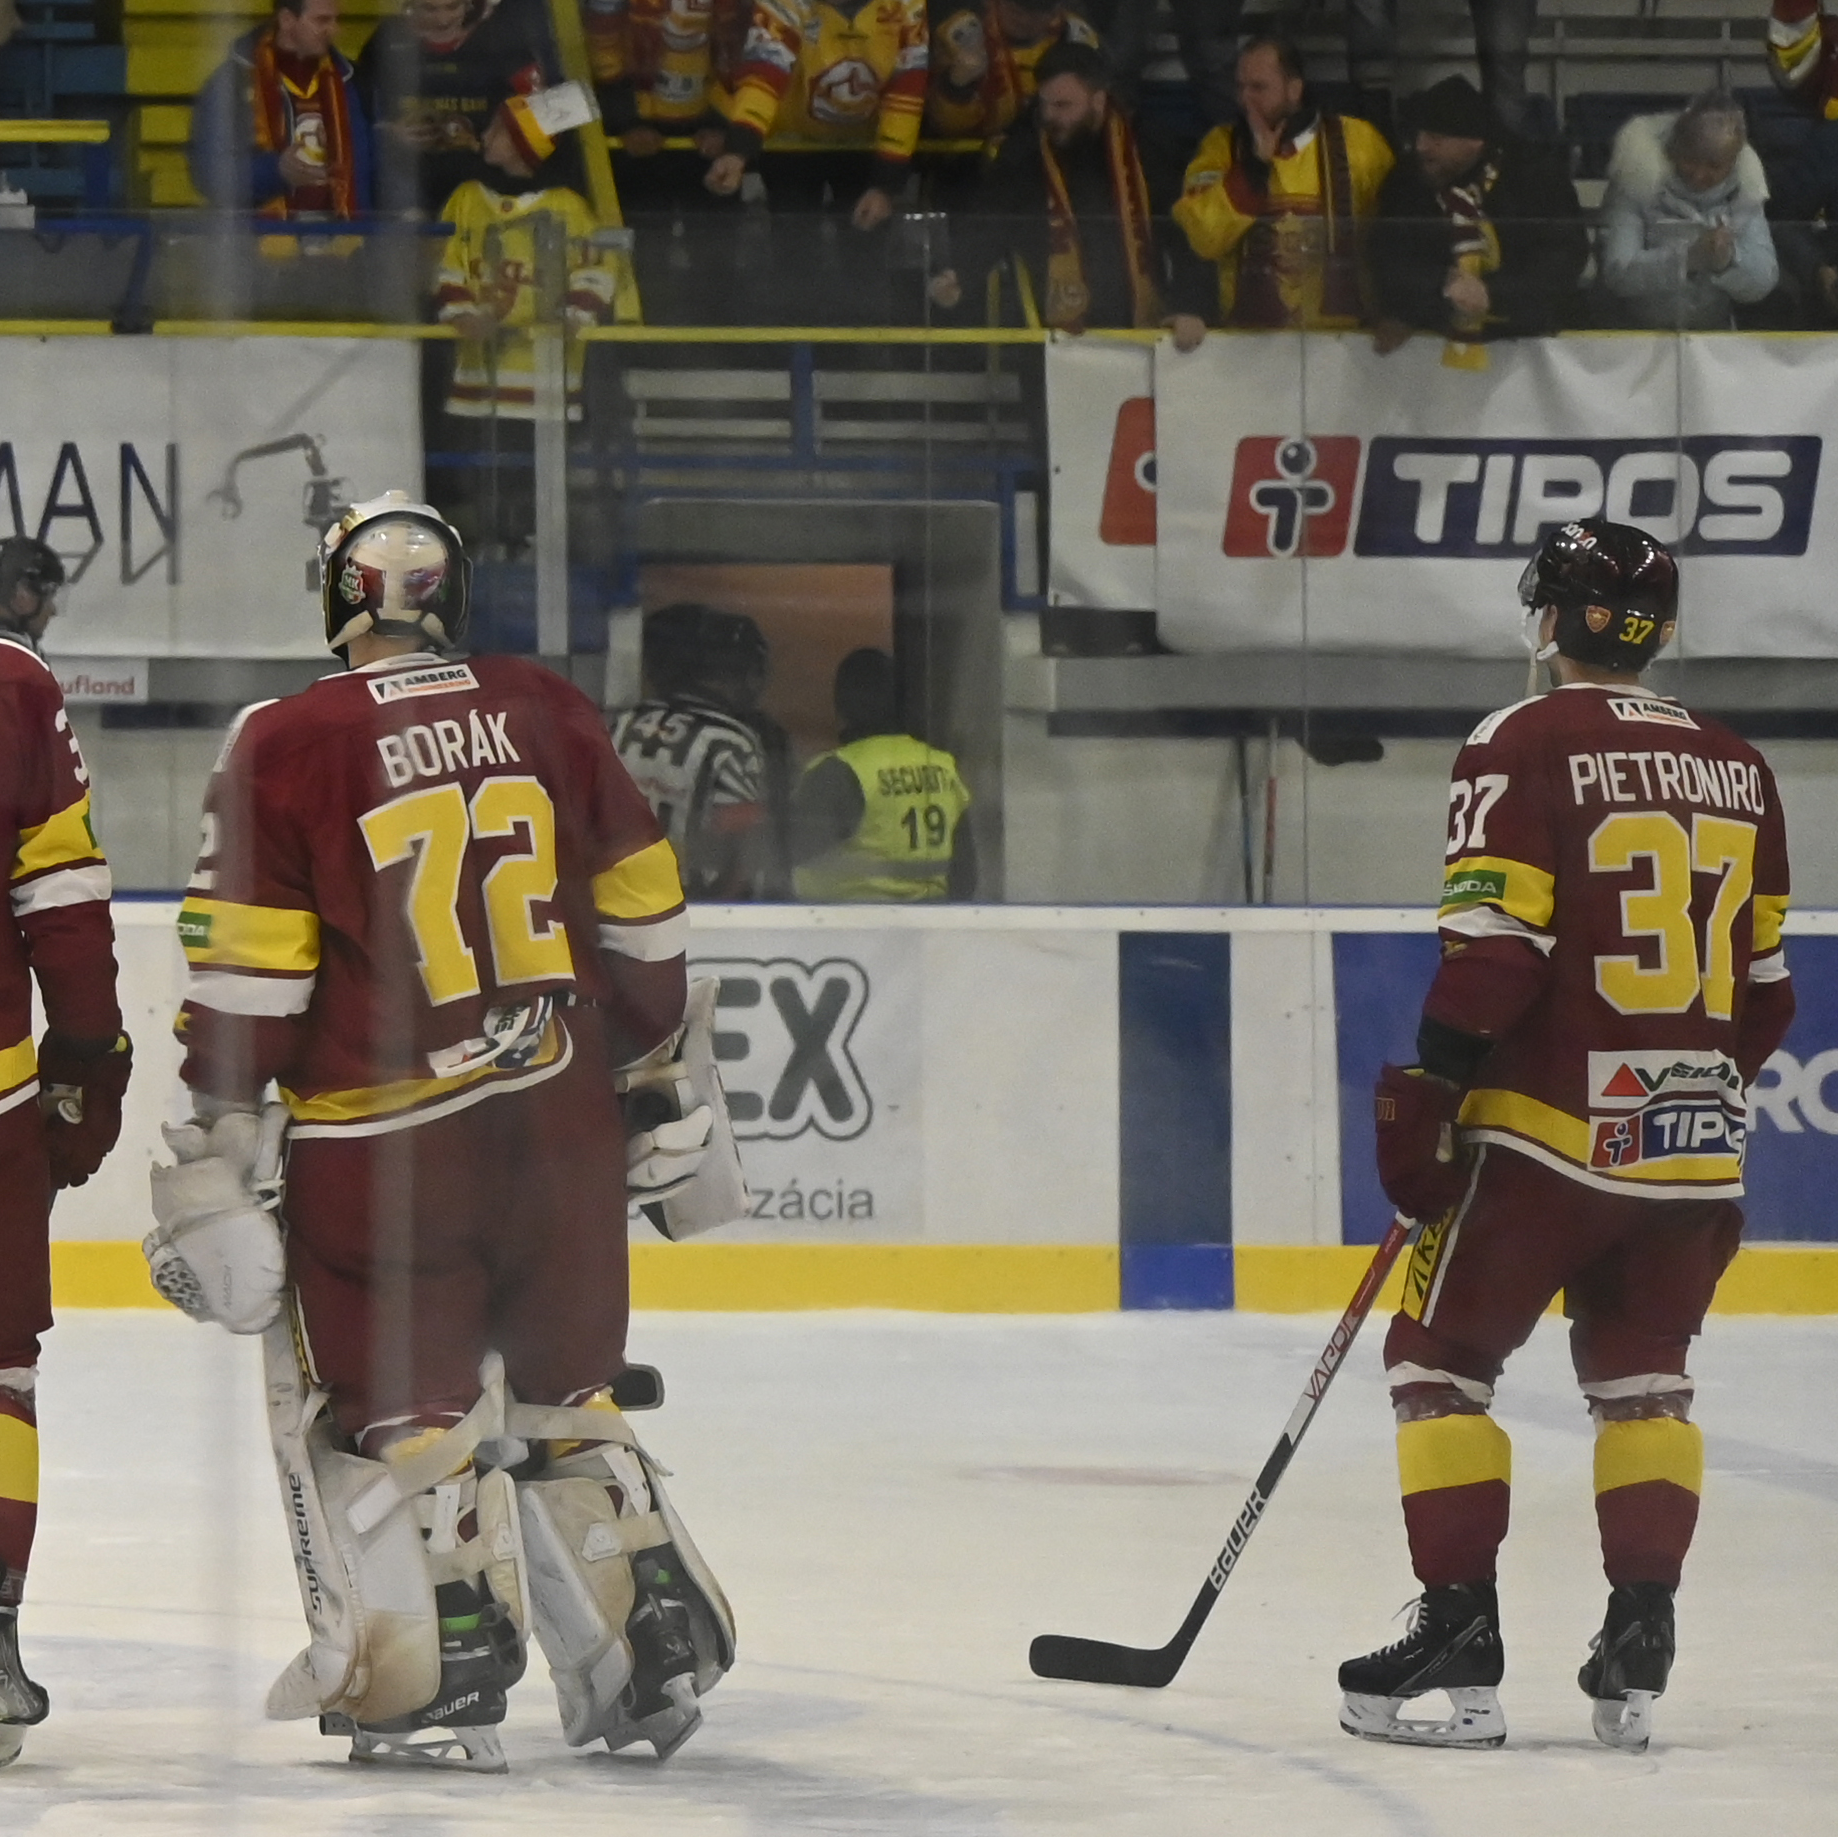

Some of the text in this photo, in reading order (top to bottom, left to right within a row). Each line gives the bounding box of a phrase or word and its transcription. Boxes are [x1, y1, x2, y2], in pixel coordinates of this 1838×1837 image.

[1392, 448, 1793, 546] TIPOS
[1618, 616, 1655, 645] 37
[402, 668, 468, 692] AMBERG
[1641, 702, 1689, 723] AMBERG
[376, 708, 522, 788] BORÁK
[1567, 750, 1766, 816] PIETRONIRO
[901, 804, 946, 851] 19
[1445, 773, 1510, 856] 37
[357, 774, 576, 1007] 72
[1587, 810, 1759, 1022] 37
[288, 1472, 323, 1616] SUPREME
[1208, 1488, 1268, 1592] BAUER
